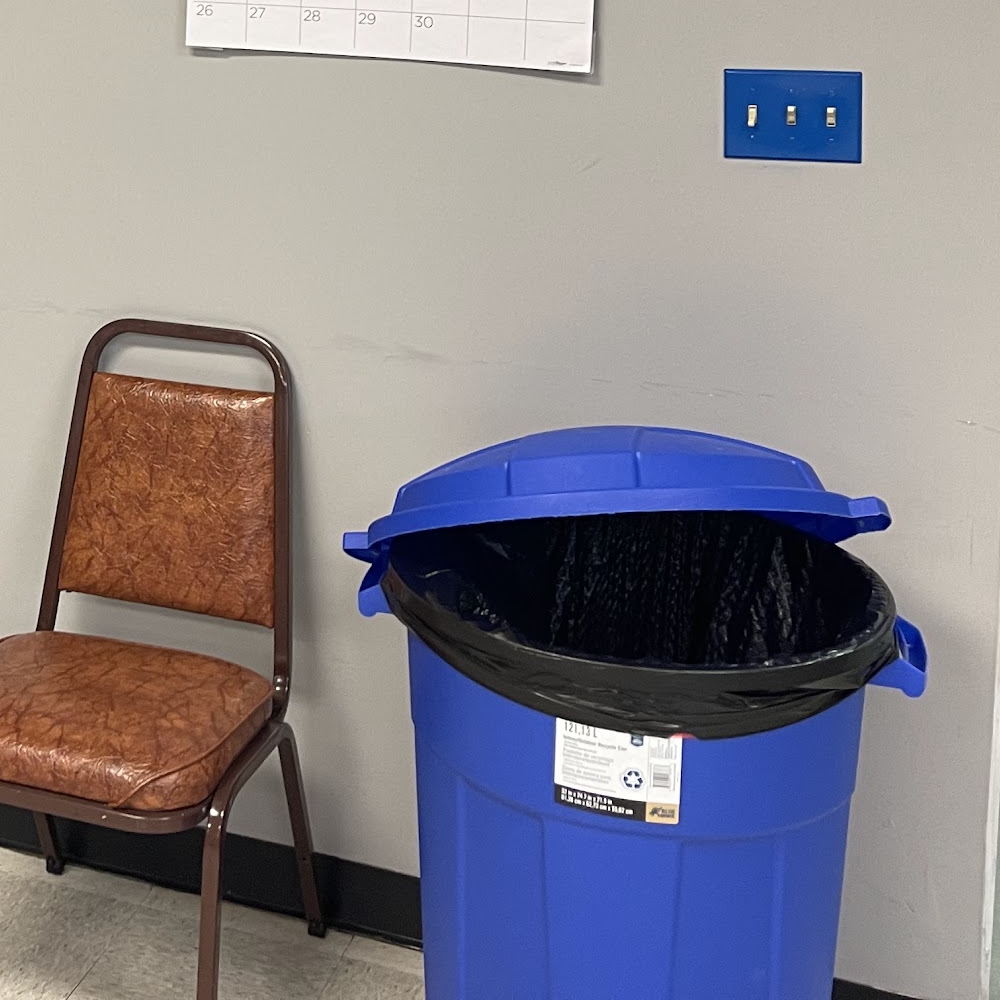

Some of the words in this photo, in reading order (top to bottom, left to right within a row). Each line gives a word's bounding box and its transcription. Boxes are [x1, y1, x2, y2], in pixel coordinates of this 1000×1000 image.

[196, 4, 213, 17] 26
[249, 7, 266, 19] 27
[303, 10, 321, 23] 28
[358, 12, 377, 25] 29
[414, 15, 434, 29] 30
